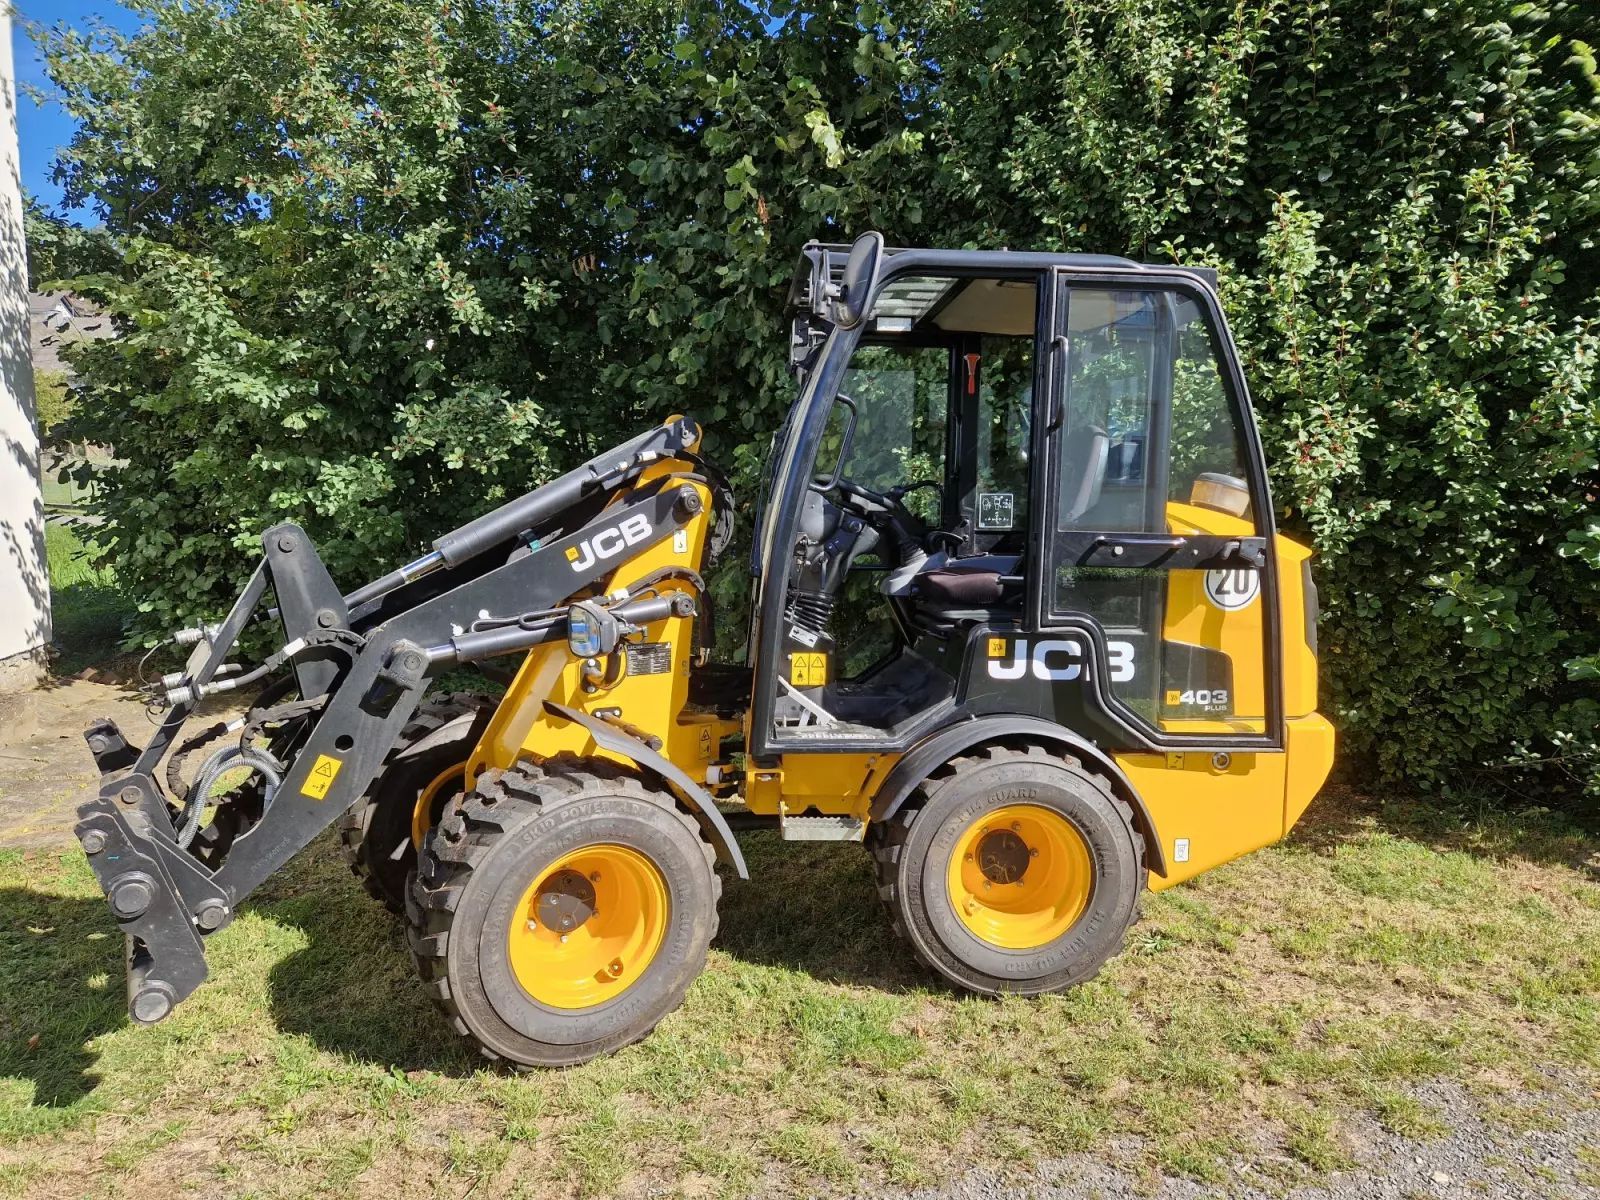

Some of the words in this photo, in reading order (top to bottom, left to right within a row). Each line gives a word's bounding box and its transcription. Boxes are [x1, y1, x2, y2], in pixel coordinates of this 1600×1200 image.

[569, 513, 653, 573] JCB
[1215, 569, 1250, 595] 20
[987, 639, 1135, 682] JCB
[1179, 690, 1228, 705] 403
[522, 817, 556, 844] SKID
